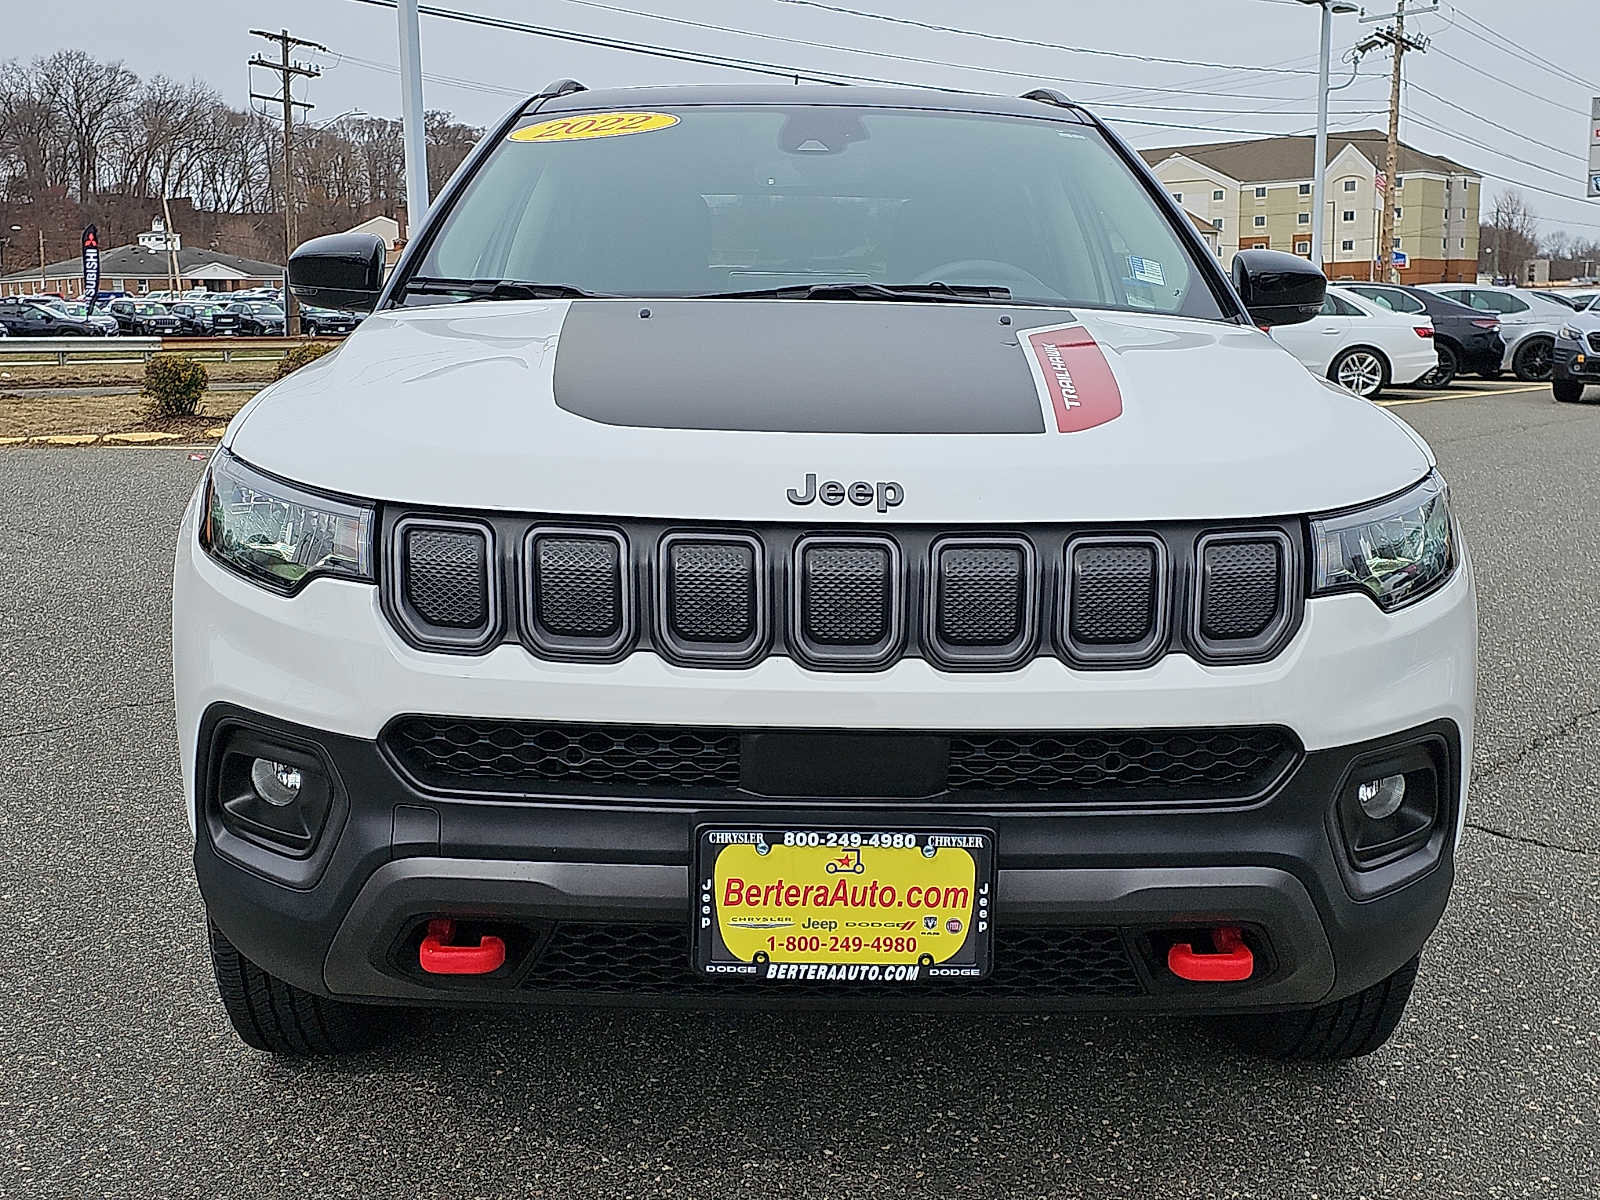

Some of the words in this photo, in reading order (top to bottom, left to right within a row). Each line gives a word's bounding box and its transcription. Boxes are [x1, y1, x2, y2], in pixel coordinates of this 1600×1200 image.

[534, 115, 652, 139] 2022
[1041, 342, 1081, 410] TRAILHAWK
[786, 473, 905, 513] Jeep
[709, 832, 765, 844] CHRYSLER
[783, 832, 916, 848] 800-249-4980
[928, 835, 984, 848] CHRYSLER
[723, 878, 969, 909] BerteraAuto.com
[802, 917, 838, 931] Jeep
[767, 936, 917, 953] 1-800-249-4980
[706, 965, 757, 974] DODGE
[766, 964, 919, 981] BERTERAAUTO.COM
